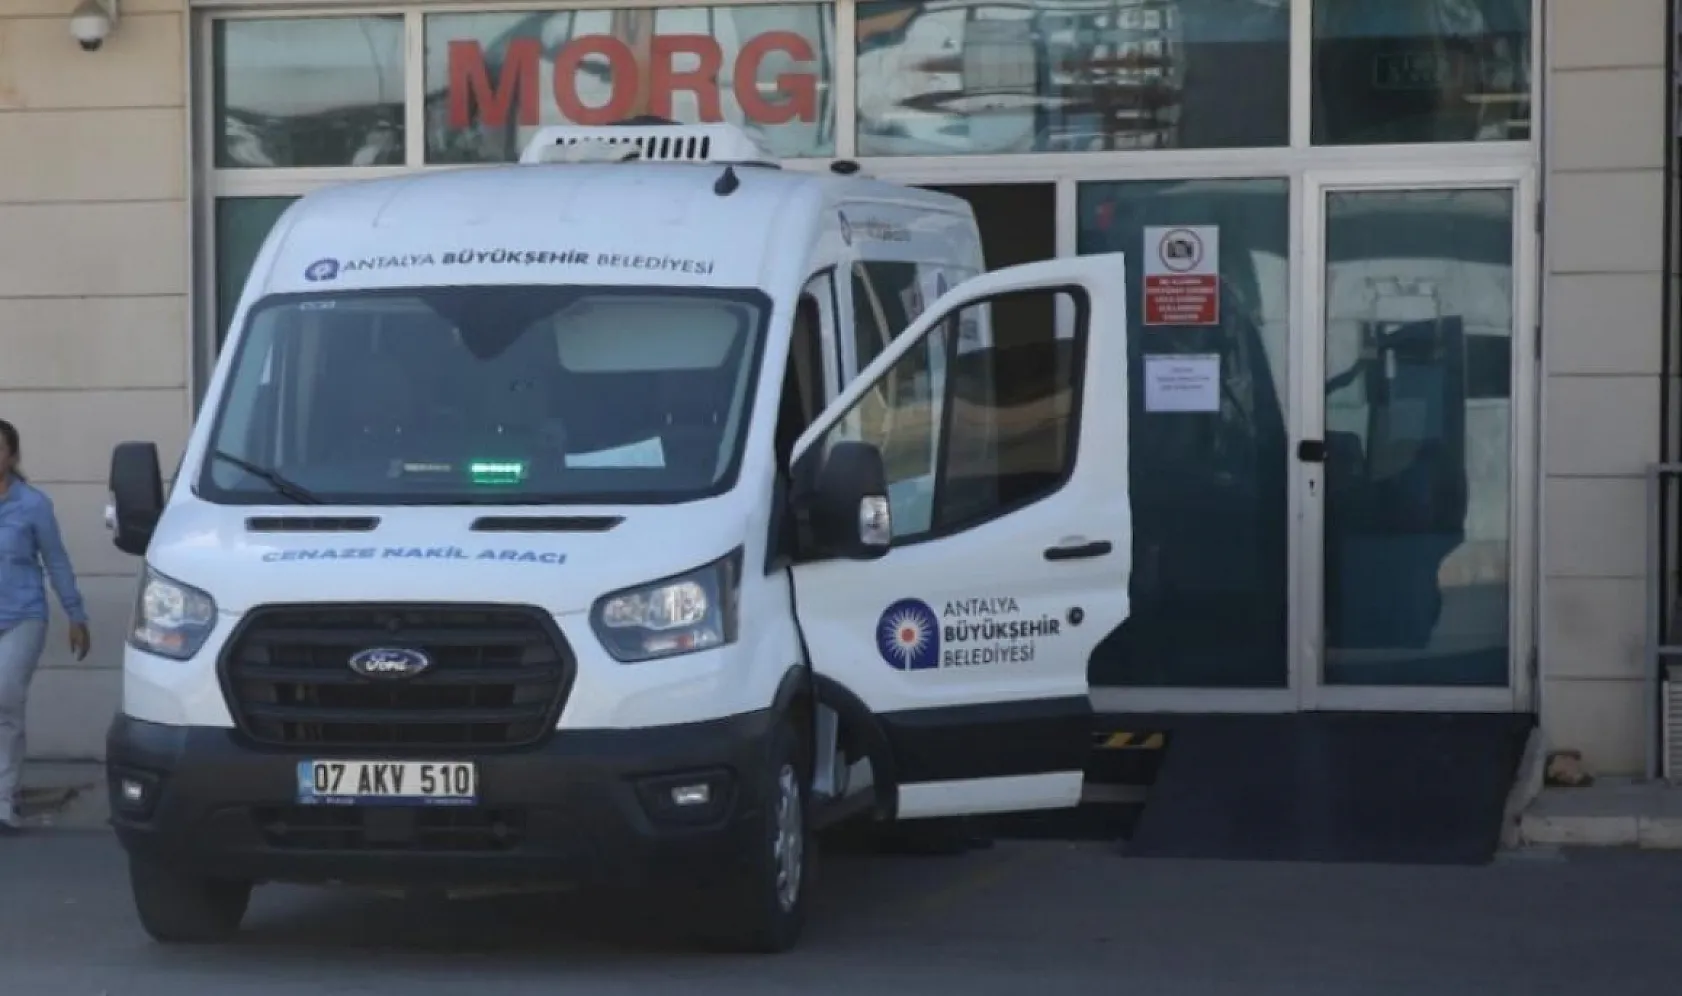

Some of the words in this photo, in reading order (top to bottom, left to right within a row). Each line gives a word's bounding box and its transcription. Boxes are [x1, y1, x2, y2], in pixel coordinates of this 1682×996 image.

[447, 30, 818, 127] MORG
[342, 252, 436, 272] ANTALYA
[442, 249, 590, 266] BÜYÜKŞEHİR
[596, 253, 715, 276] BELEDİYESİ
[262, 547, 377, 563] CENAZE
[381, 545, 469, 560] NAKİL
[475, 549, 568, 565] ARACI
[943, 597, 1020, 617] ANTALYA
[943, 613, 1061, 643] BÜYÜKŞEHİR
[943, 640, 1035, 667] BELEDİYESİ
[314, 763, 346, 792] 07
[358, 763, 405, 794] AKV
[420, 764, 470, 794] 510
